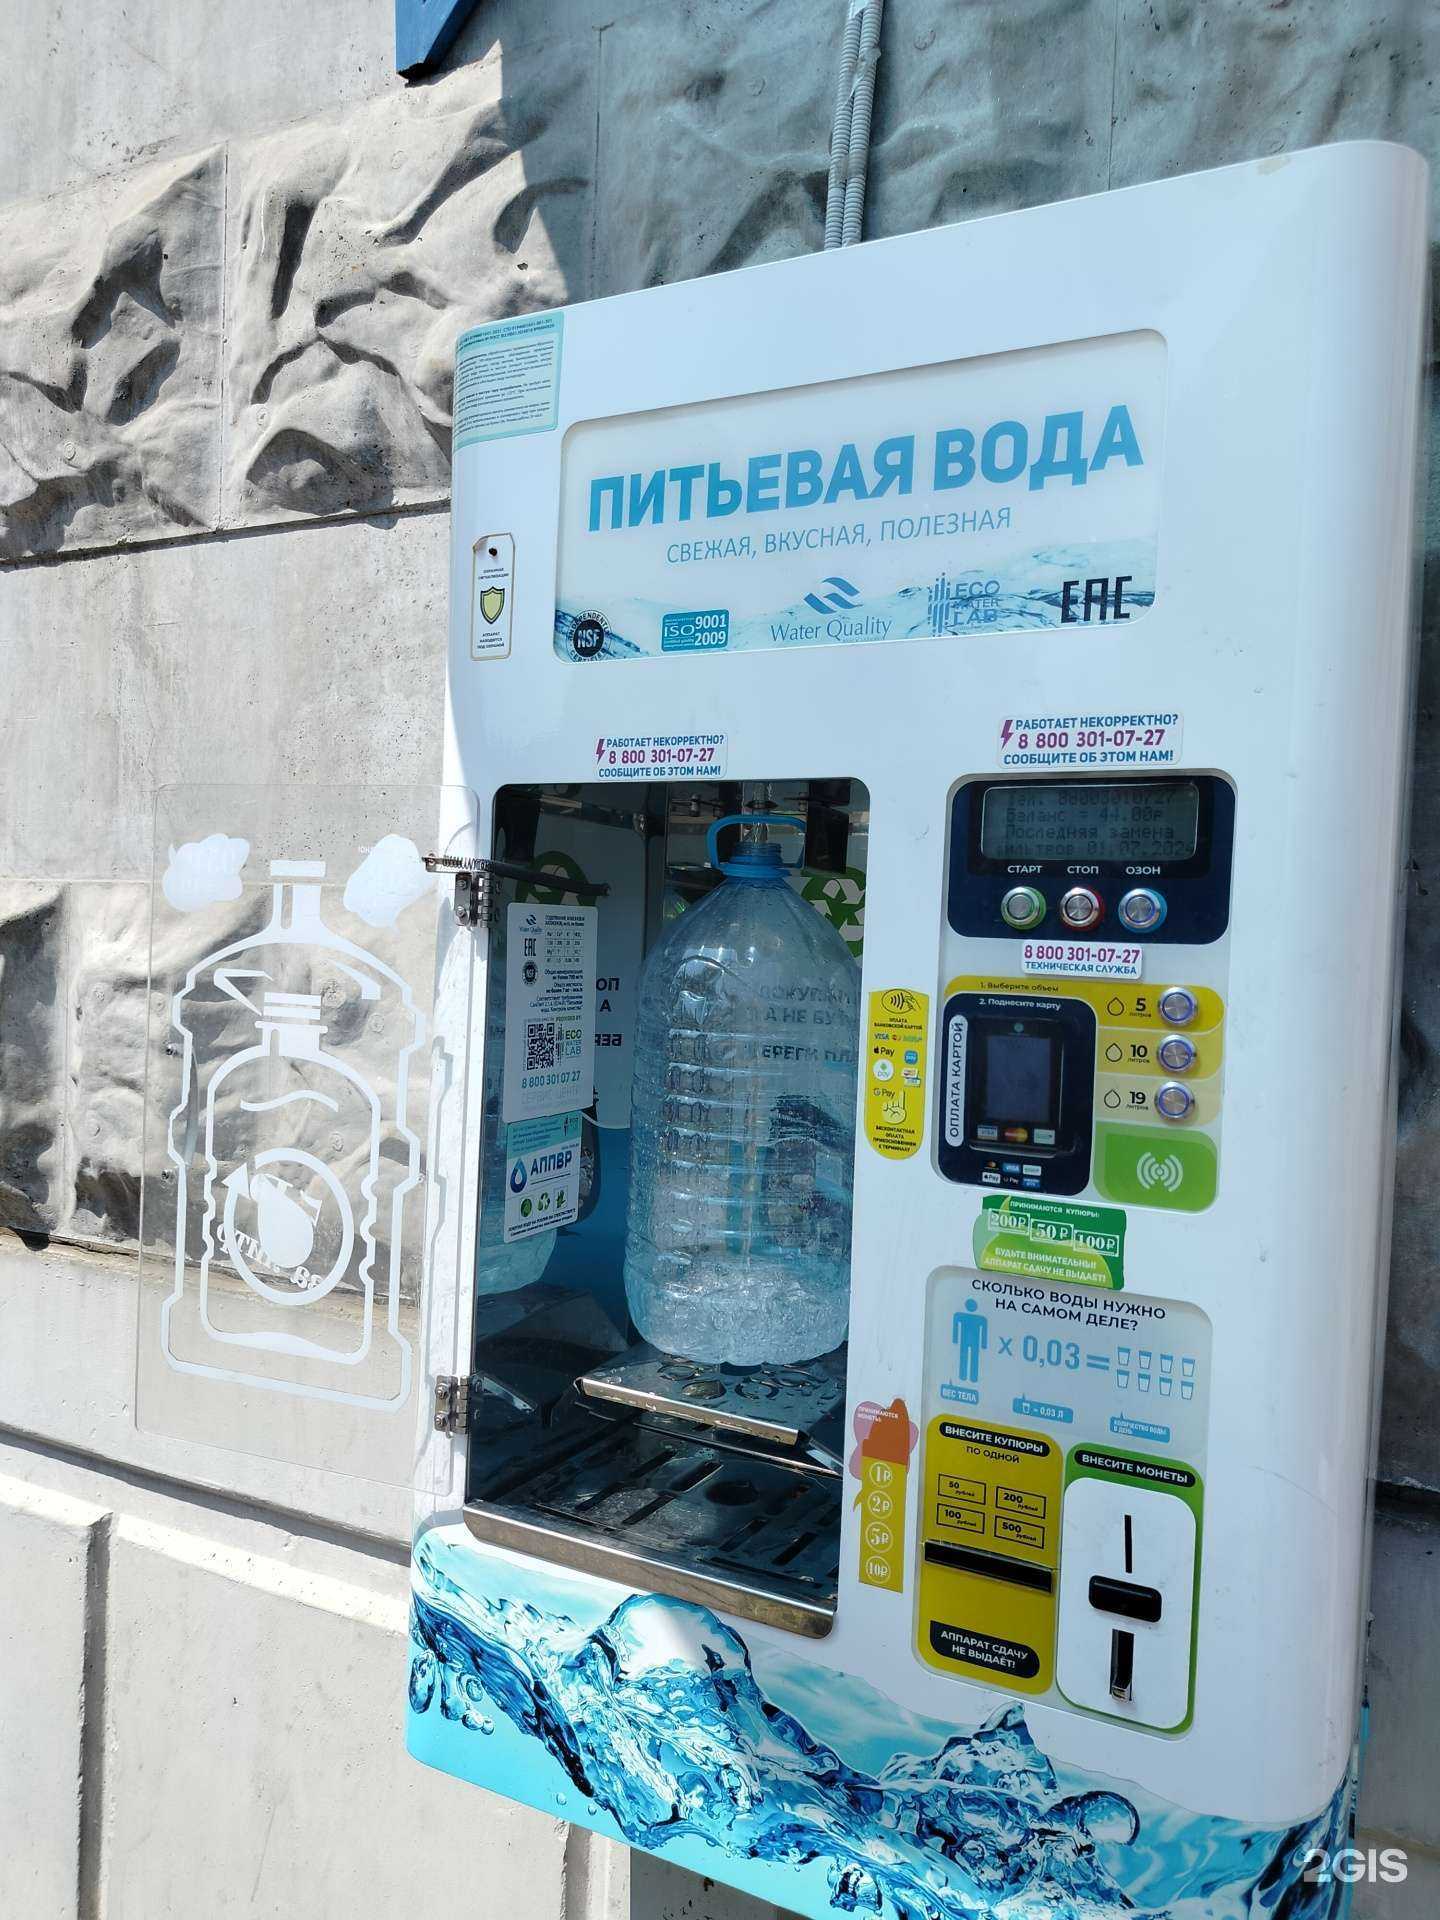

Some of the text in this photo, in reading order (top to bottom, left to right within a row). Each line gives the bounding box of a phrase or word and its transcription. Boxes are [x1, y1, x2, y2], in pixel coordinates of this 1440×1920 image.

[588, 404, 1143, 531] ПИТЬЕВАЯ ВОДА
[667, 507, 1011, 563] СВЕЖАЯ, ВКУСНАЯ, ПОЛЕЗНАЯ
[954, 580, 1000, 597] ECO
[695, 614, 727, 630] 9001
[953, 609, 998, 626] LAB
[664, 623, 695, 638] ISO
[770, 615, 892, 642] Water Quality
[576, 629, 601, 649] NSF
[694, 631, 726, 647] 2009
[1015, 714, 1178, 730] РАБОТАЕТ НЕКОРРЕКТНО?
[607, 734, 724, 747] РАБОТАЕТ НЕКОРРЕКТНО?
[1018, 729, 1166, 749] 8 800 301-07-27
[609, 747, 715, 764] 8 800 301-07-27
[1004, 750, 1174, 765] СООБЩИТЕ ОБ ЭТОМ НАМ!
[599, 765, 721, 778] СООБЩИТЕ ОБ ЭТОМ НАМ!
[1007, 865, 1161, 875] СТАРТ СТОП ОЗОН
[1024, 945, 1140, 964] 8 800 301-07-27
[1025, 961, 1137, 975] ТЕХНИЧЕСКАЯ СЛУЖБА
[987, 982, 1029, 991] Выберите
[988, 998, 1035, 1007] Поднесите
[1036, 1001, 1061, 1011] карту
[1136, 998, 1146, 1011] 5
[565, 1028, 582, 1040] ECO
[564, 1046, 582, 1056] LAB
[880, 1046, 895, 1057] Pay
[1130, 1044, 1148, 1058] 10
[521, 1077, 528, 1089] 8
[529, 1075, 544, 1087] 800
[560, 1072, 570, 1084] 07
[571, 1070, 581, 1082] 27
[950, 1022, 964, 1137] ОПЛАТА КАРТОЙ
[1129, 1091, 1146, 1104] 19
[530, 1150, 573, 1176] АППВР
[1010, 1200, 1063, 1214] ПРИНИМАЮТСЯ
[994, 1247, 1027, 1259] БУДЬТЕ
[1024, 1262, 1051, 1275] СДАЧУ
[1052, 1267, 1064, 1276] НЕ
[971, 1279, 1166, 1320] СКОЛЬКО ВОДЫ НУЖНО
[995, 1298, 1138, 1332] НА САМОМ ДЕЛЕ?
[1022, 1334, 1080, 1371] 0,03
[1039, 1405, 1056, 1417] 0,03
[945, 1425, 1043, 1454] ВНЕСИТЕ КУПЮРЫ
[966, 1445, 1020, 1464] ПО ОДНОЙ
[1082, 1454, 1188, 1483] ВНЕСИТЕ МОНЕТЫ
[948, 1481, 960, 1489] 50
[1003, 1492, 1023, 1504] 200
[945, 1509, 961, 1519] 100
[1002, 1521, 1022, 1533] 500
[941, 1630, 1028, 1661] АППАРАТ СДАЧУ
[951, 1644, 1016, 1670] НЕ ВЫДАЁТ!
